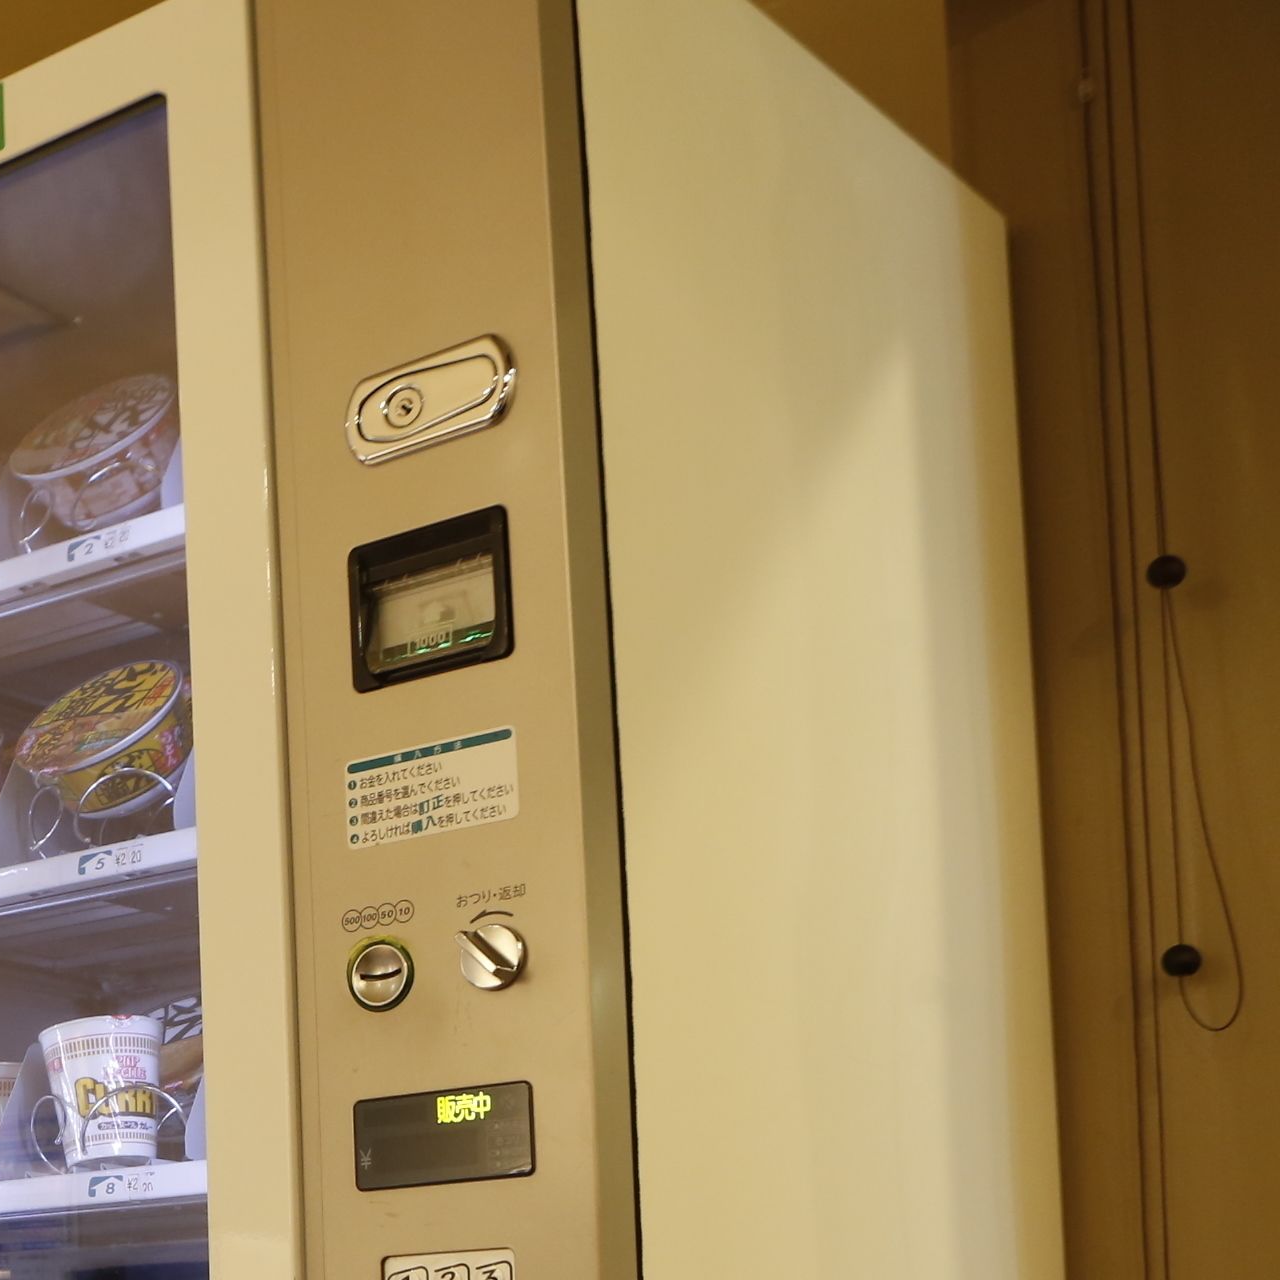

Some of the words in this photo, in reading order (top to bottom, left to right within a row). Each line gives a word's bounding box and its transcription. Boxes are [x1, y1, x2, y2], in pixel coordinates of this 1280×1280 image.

[380, 910, 394, 919] 50
[398, 906, 411, 916] 10
[437, 1091, 491, 1124] 販売中
[106, 1182, 115, 1195] 8
